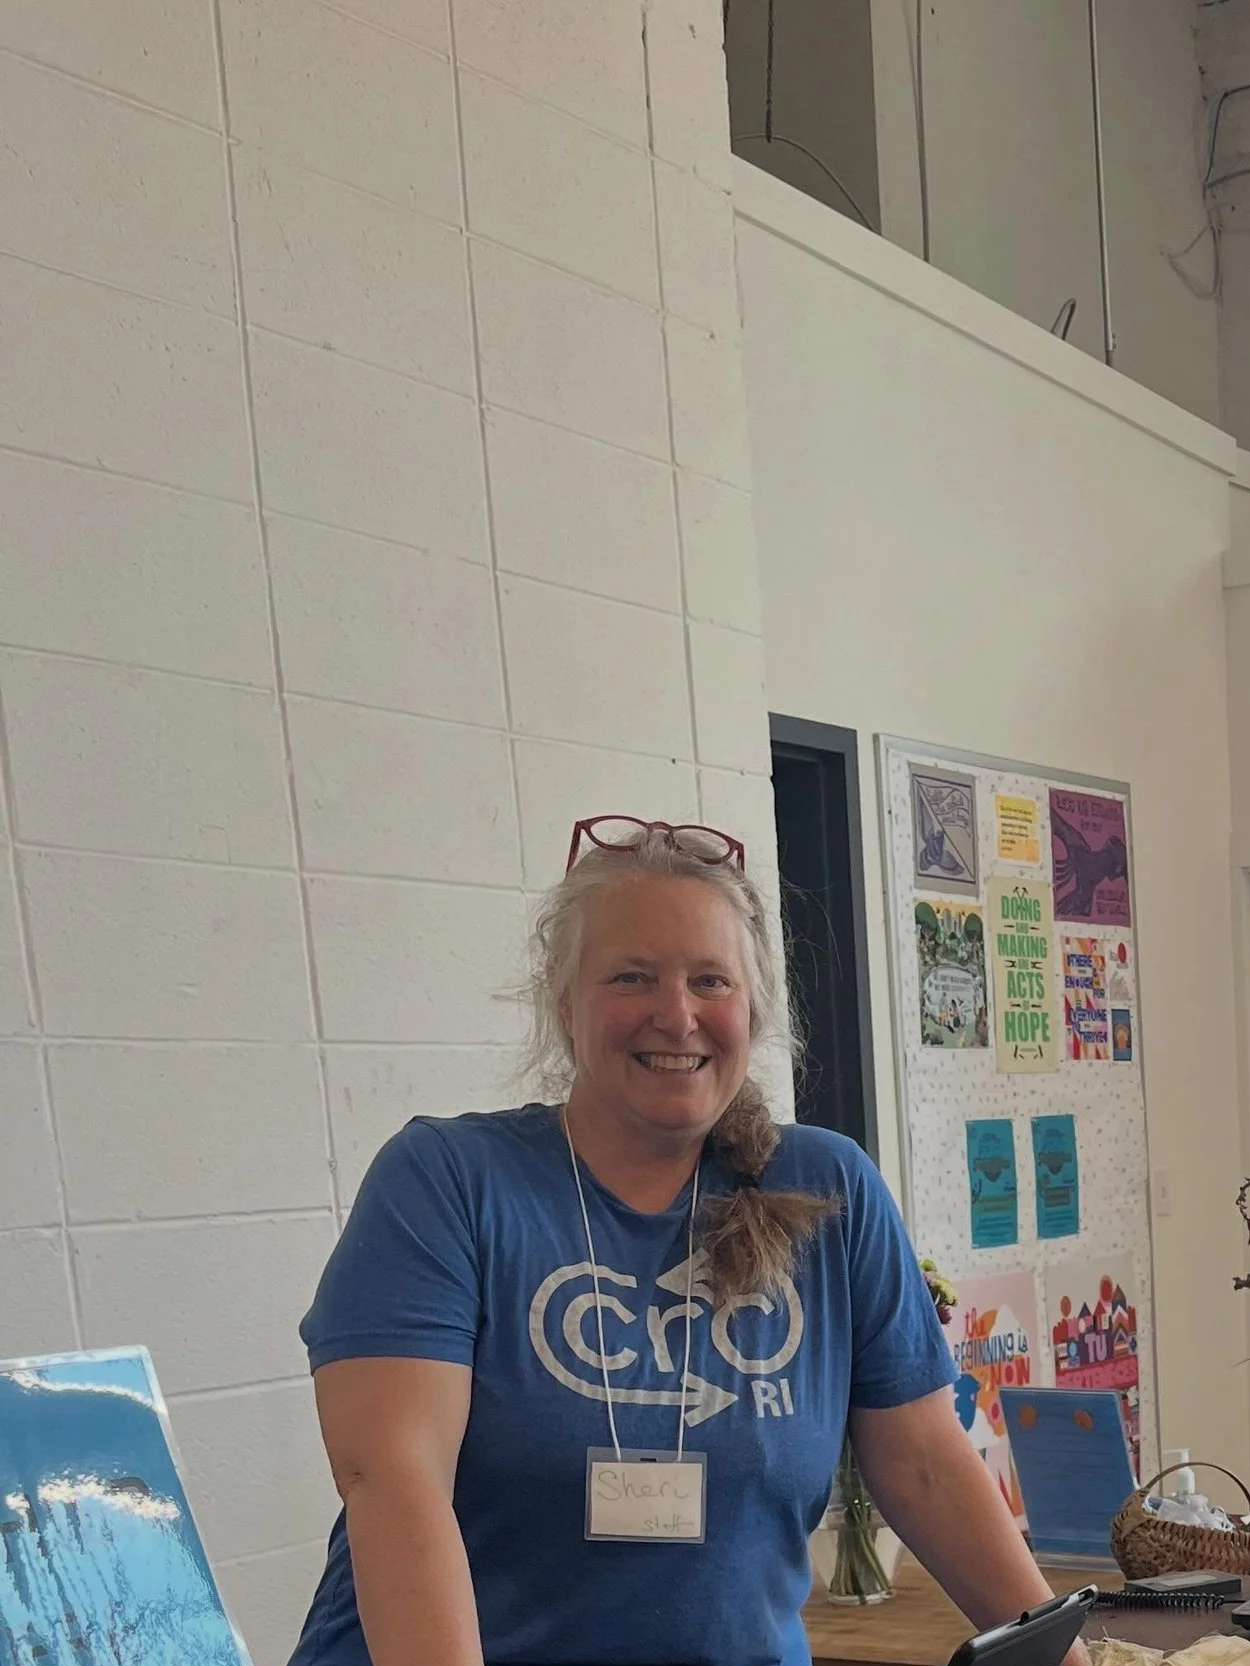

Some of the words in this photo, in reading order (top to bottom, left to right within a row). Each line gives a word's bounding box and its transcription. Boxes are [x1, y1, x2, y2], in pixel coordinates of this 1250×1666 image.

[1001, 895, 1041, 922] DOING
[997, 934, 1048, 958] MAKING
[1007, 971, 1045, 999] ACTS
[1004, 1012, 1051, 1042] HOPE
[991, 1354, 1030, 1390] NOW
[750, 1377, 795, 1419] RI
[598, 1470, 690, 1501] Sheri
